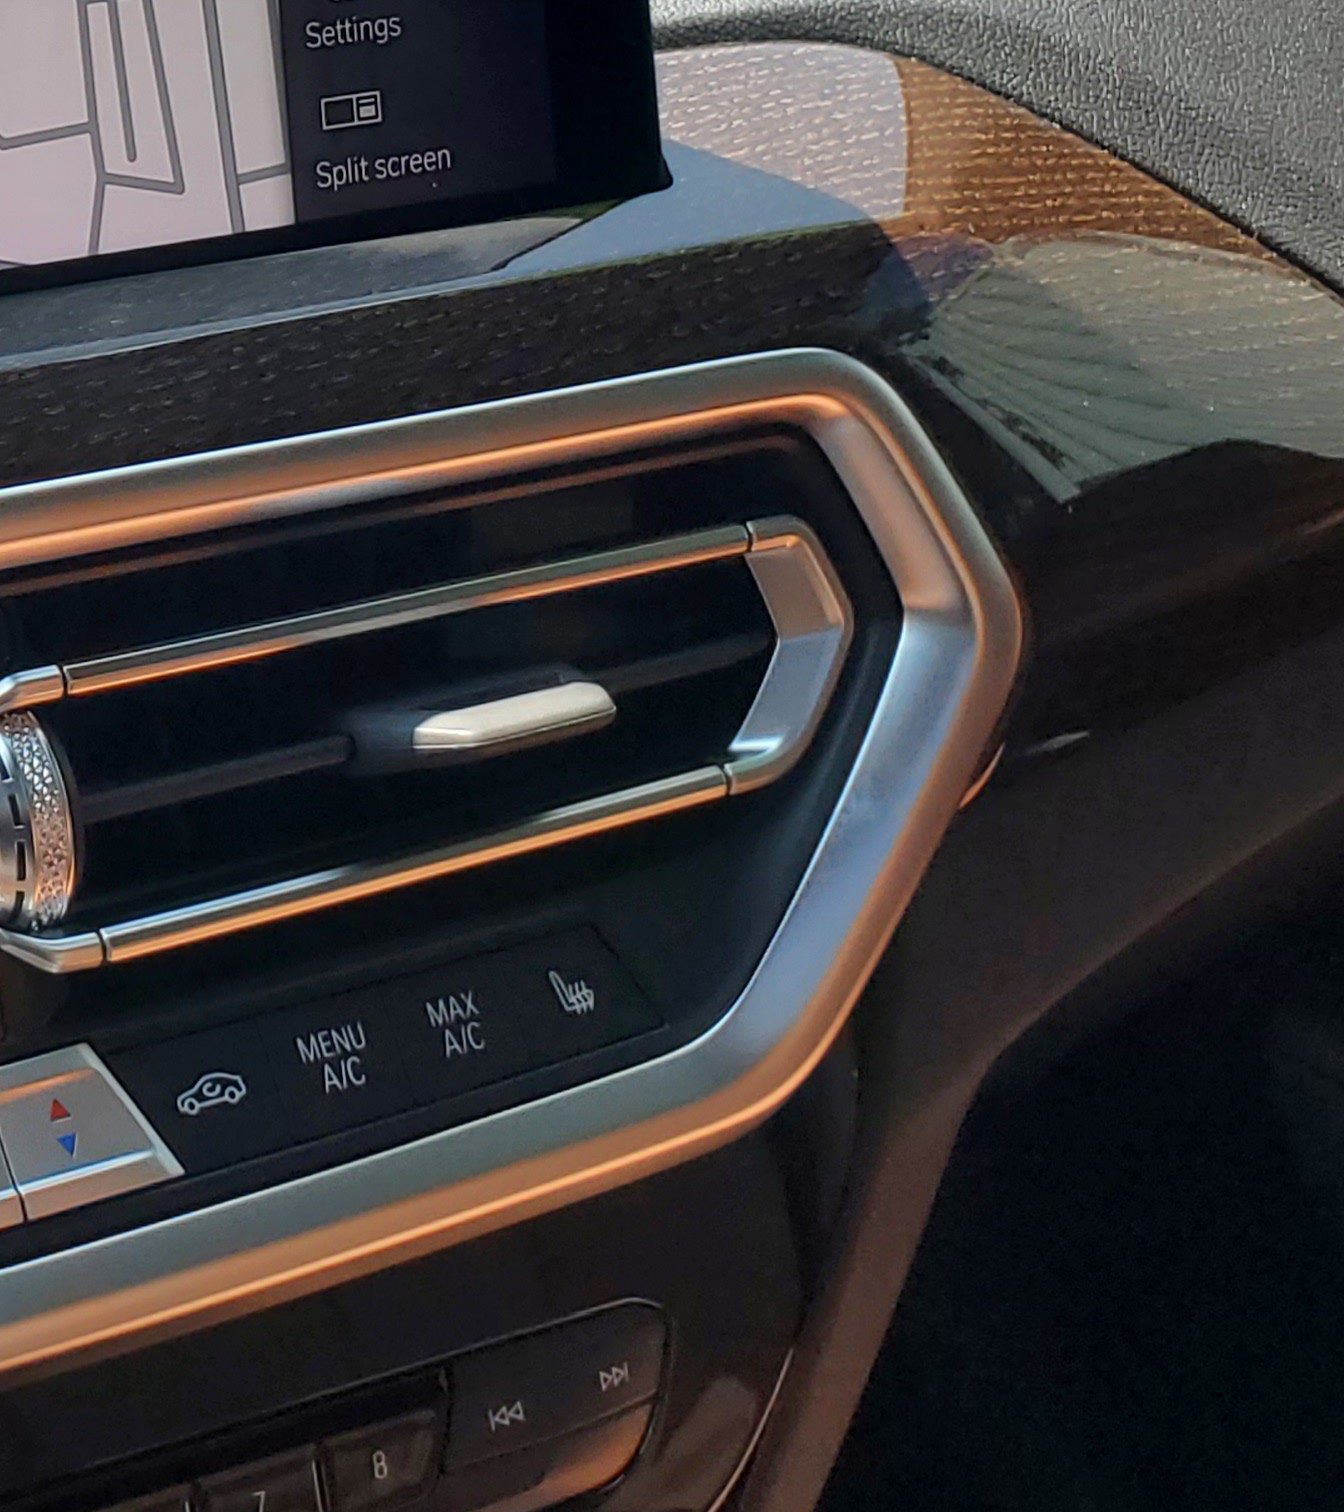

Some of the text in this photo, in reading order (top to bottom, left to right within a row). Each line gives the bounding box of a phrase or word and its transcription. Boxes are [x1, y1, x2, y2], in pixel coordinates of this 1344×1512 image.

[305, 14, 403, 49] Settings
[315, 146, 452, 192] Split screen
[424, 990, 481, 1030] MAX
[295, 1021, 367, 1066] MENU
[443, 1022, 486, 1060] A/C
[322, 1056, 367, 1096] A/C
[372, 1449, 389, 1480] 8
